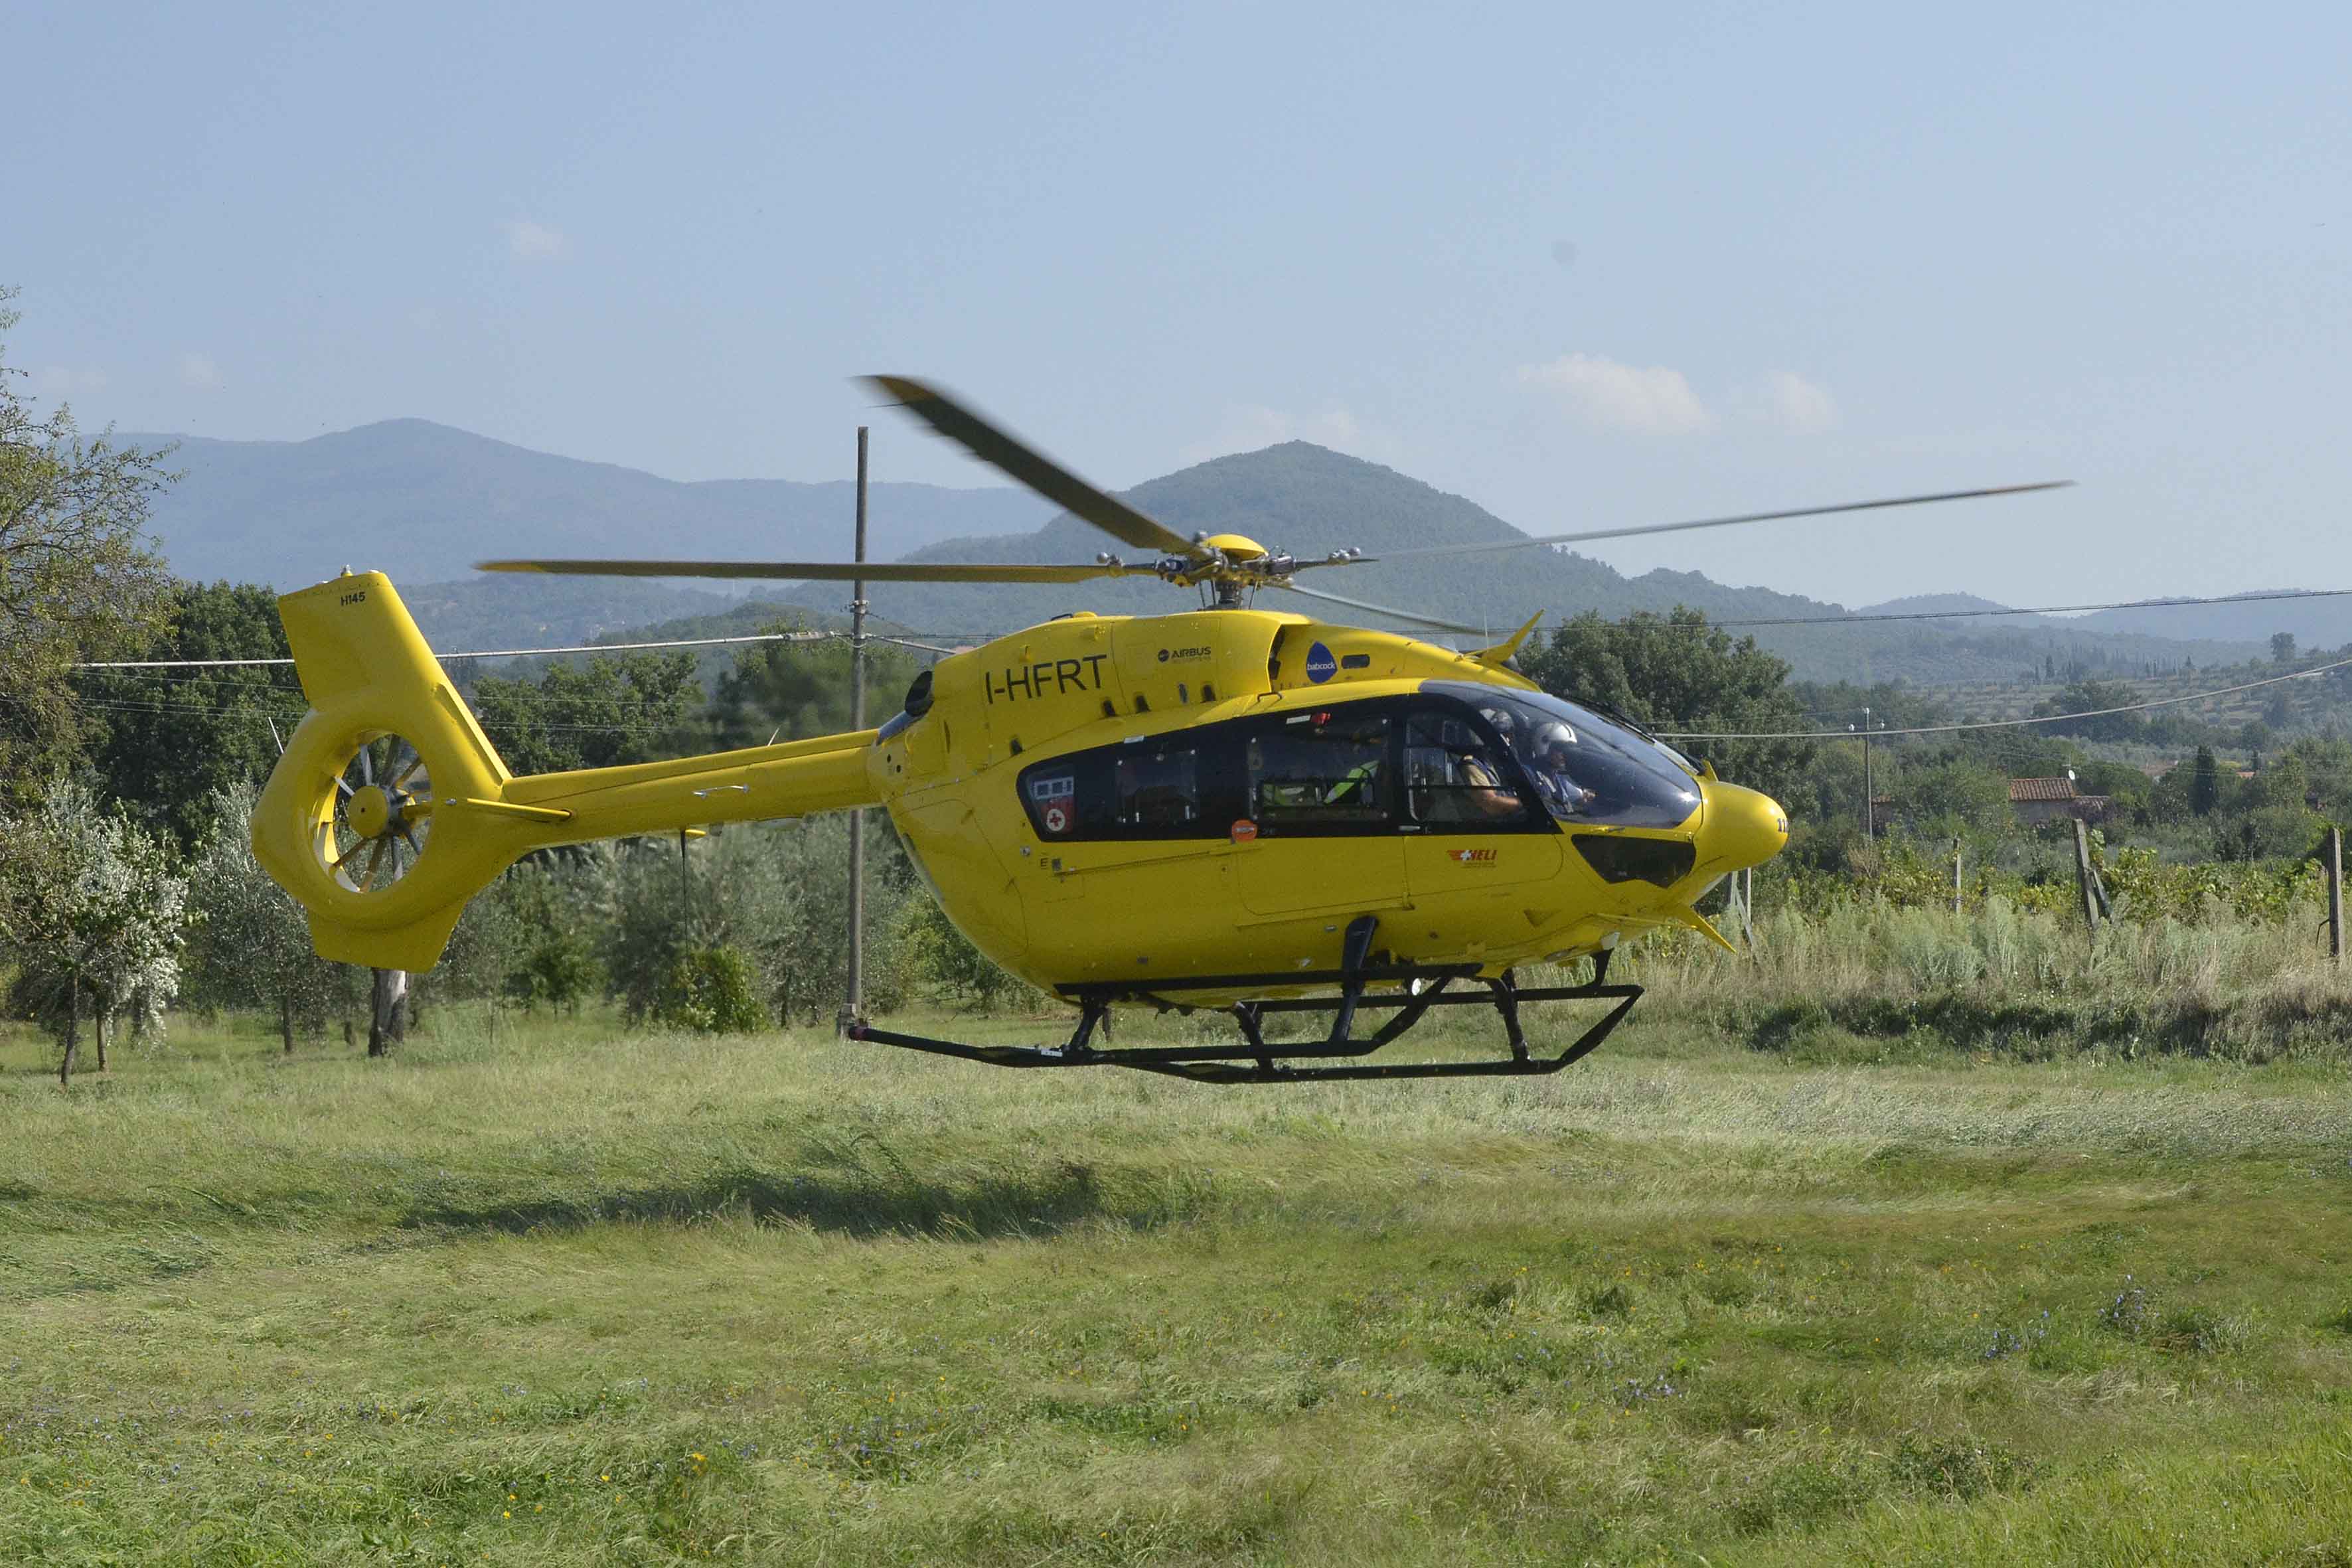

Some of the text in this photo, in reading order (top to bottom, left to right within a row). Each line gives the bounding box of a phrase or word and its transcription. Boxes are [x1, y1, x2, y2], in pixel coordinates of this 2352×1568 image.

[341, 591, 366, 605] H145
[1171, 647, 1211, 659] AIRBUS
[1306, 662, 1336, 670] babcock
[986, 655, 1107, 704] I-HFRT
